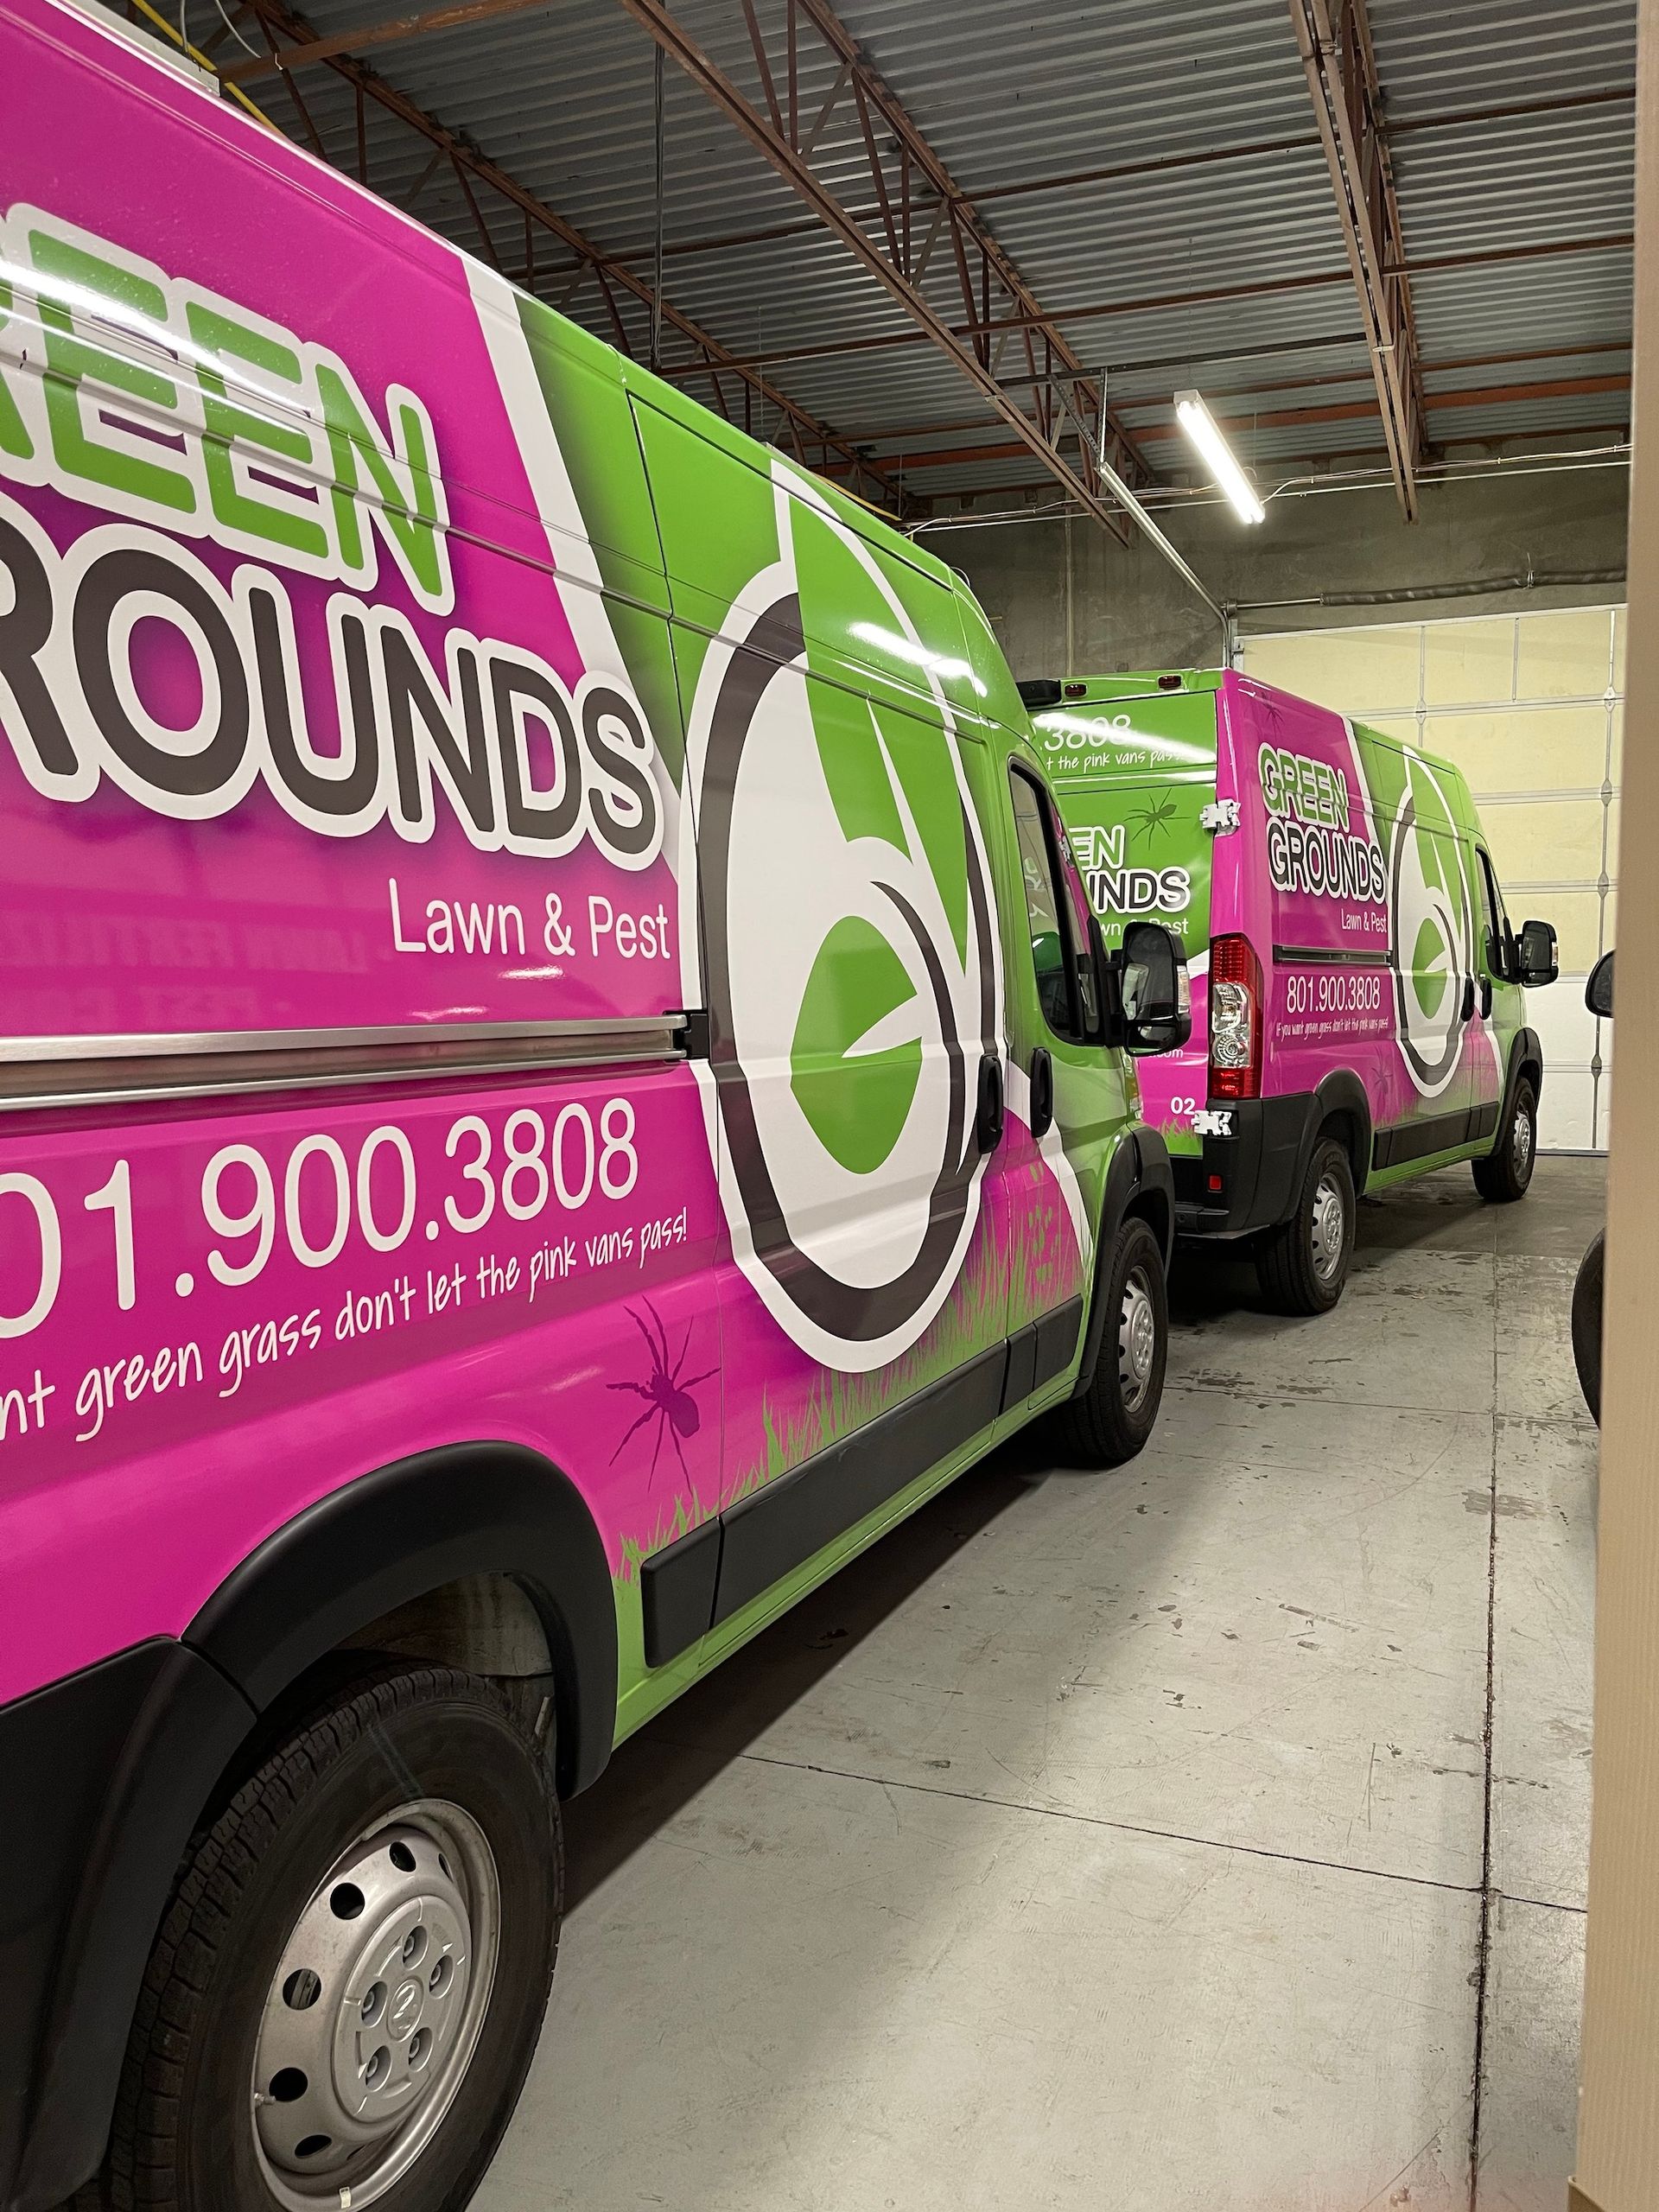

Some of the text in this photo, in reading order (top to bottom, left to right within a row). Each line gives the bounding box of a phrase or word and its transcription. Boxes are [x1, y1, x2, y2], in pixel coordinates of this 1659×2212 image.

[0, 202, 454, 616] EEN
[1058, 755, 1080, 770] the
[1084, 752, 1110, 774] pink
[1115, 750, 1147, 766] vans
[1258, 741, 1350, 834] GREEN
[1266, 816, 1386, 905] GROUNDS
[388, 878, 526, 955] Lawn
[543, 893, 576, 958] &
[588, 895, 671, 960] Pest
[1341, 908, 1387, 933] Lawn & Pest
[1287, 976, 1381, 1014] 801.900.3808
[1170, 1096, 1196, 1116] 02
[75, 1342, 205, 1442] green
[218, 1308, 321, 1397] grass
[334, 1275, 416, 1340] don't
[427, 1262, 467, 1315] let
[476, 1254, 521, 1300] the
[529, 1236, 578, 1303] pink
[585, 1226, 634, 1268] vans
[639, 1206, 689, 1269] pass!
